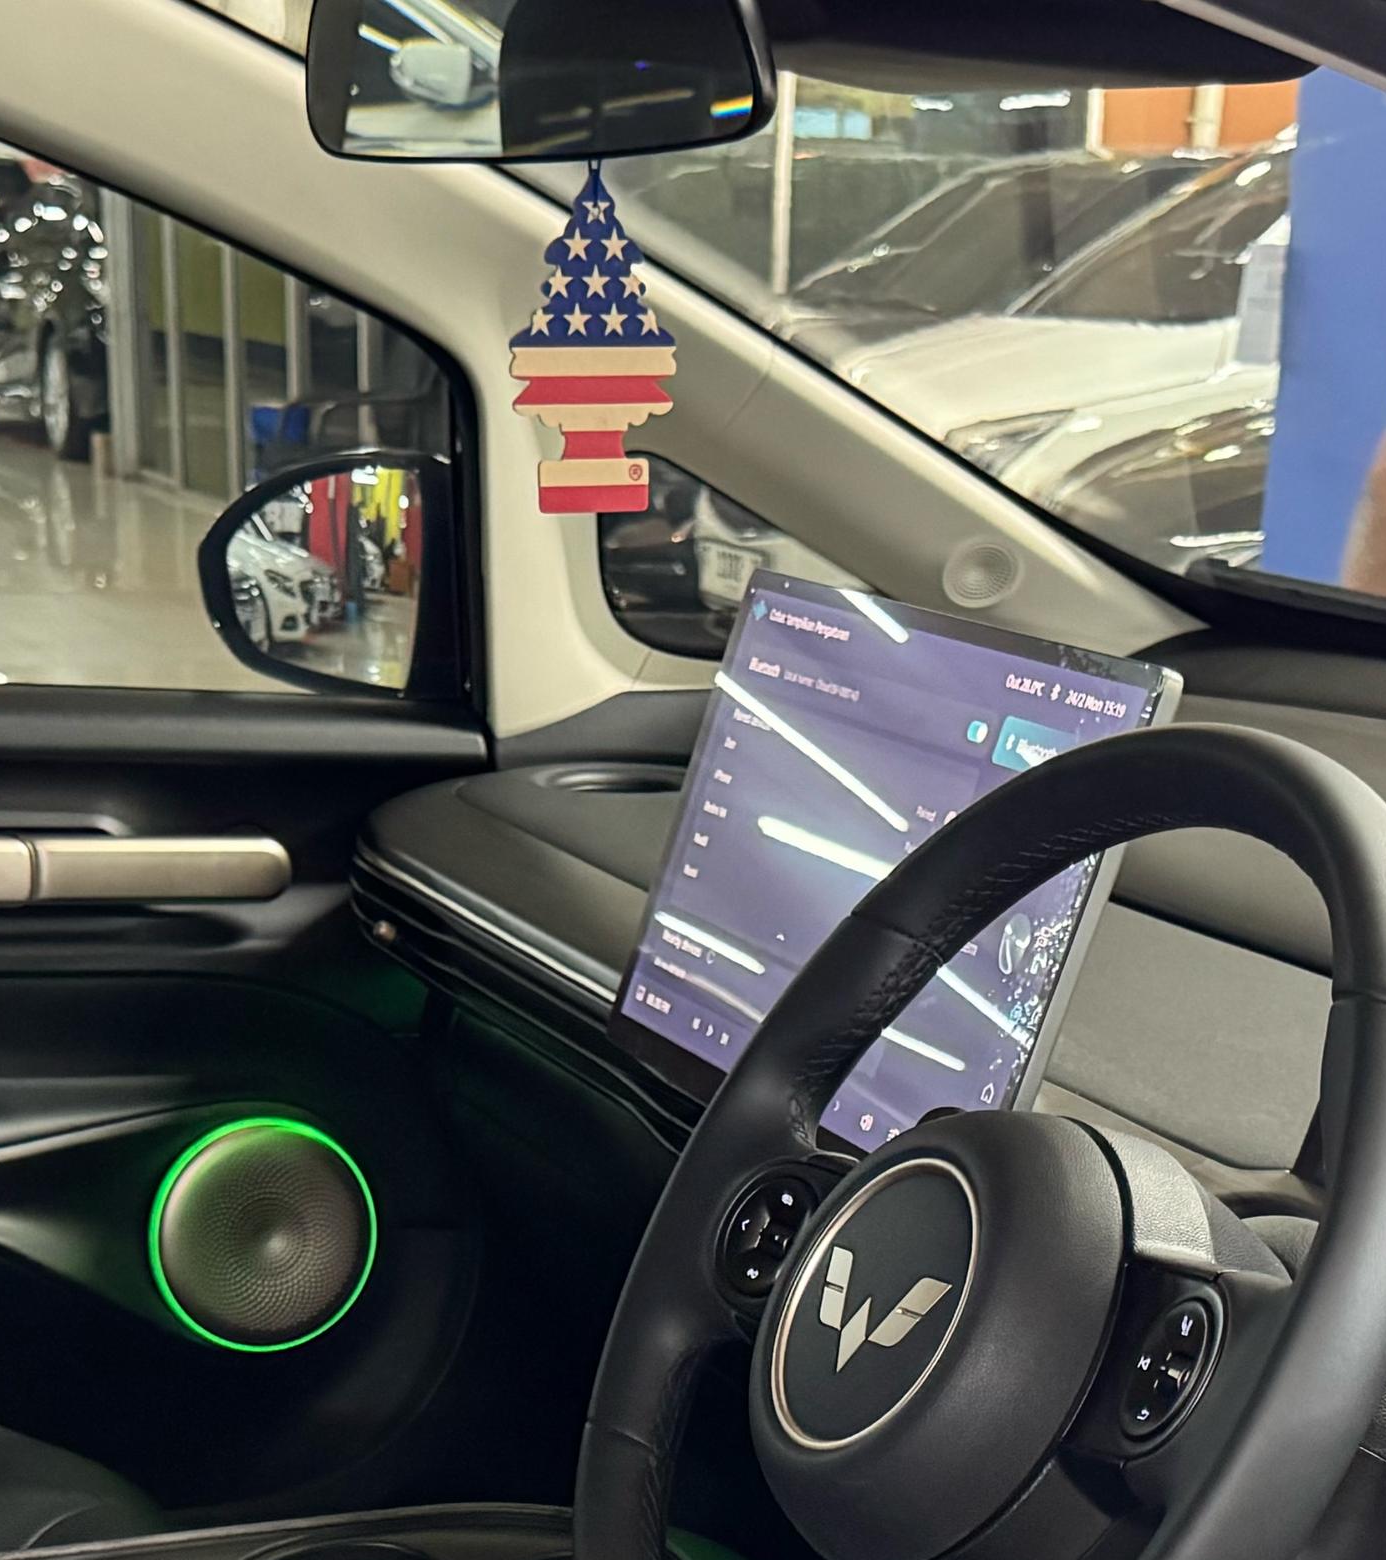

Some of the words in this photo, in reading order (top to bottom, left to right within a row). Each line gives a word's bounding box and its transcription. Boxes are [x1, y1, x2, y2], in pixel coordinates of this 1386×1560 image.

[1065, 690, 1084, 708] 24/2
[1084, 695, 1103, 712] Mon
[1103, 700, 1126, 718] 15:19
